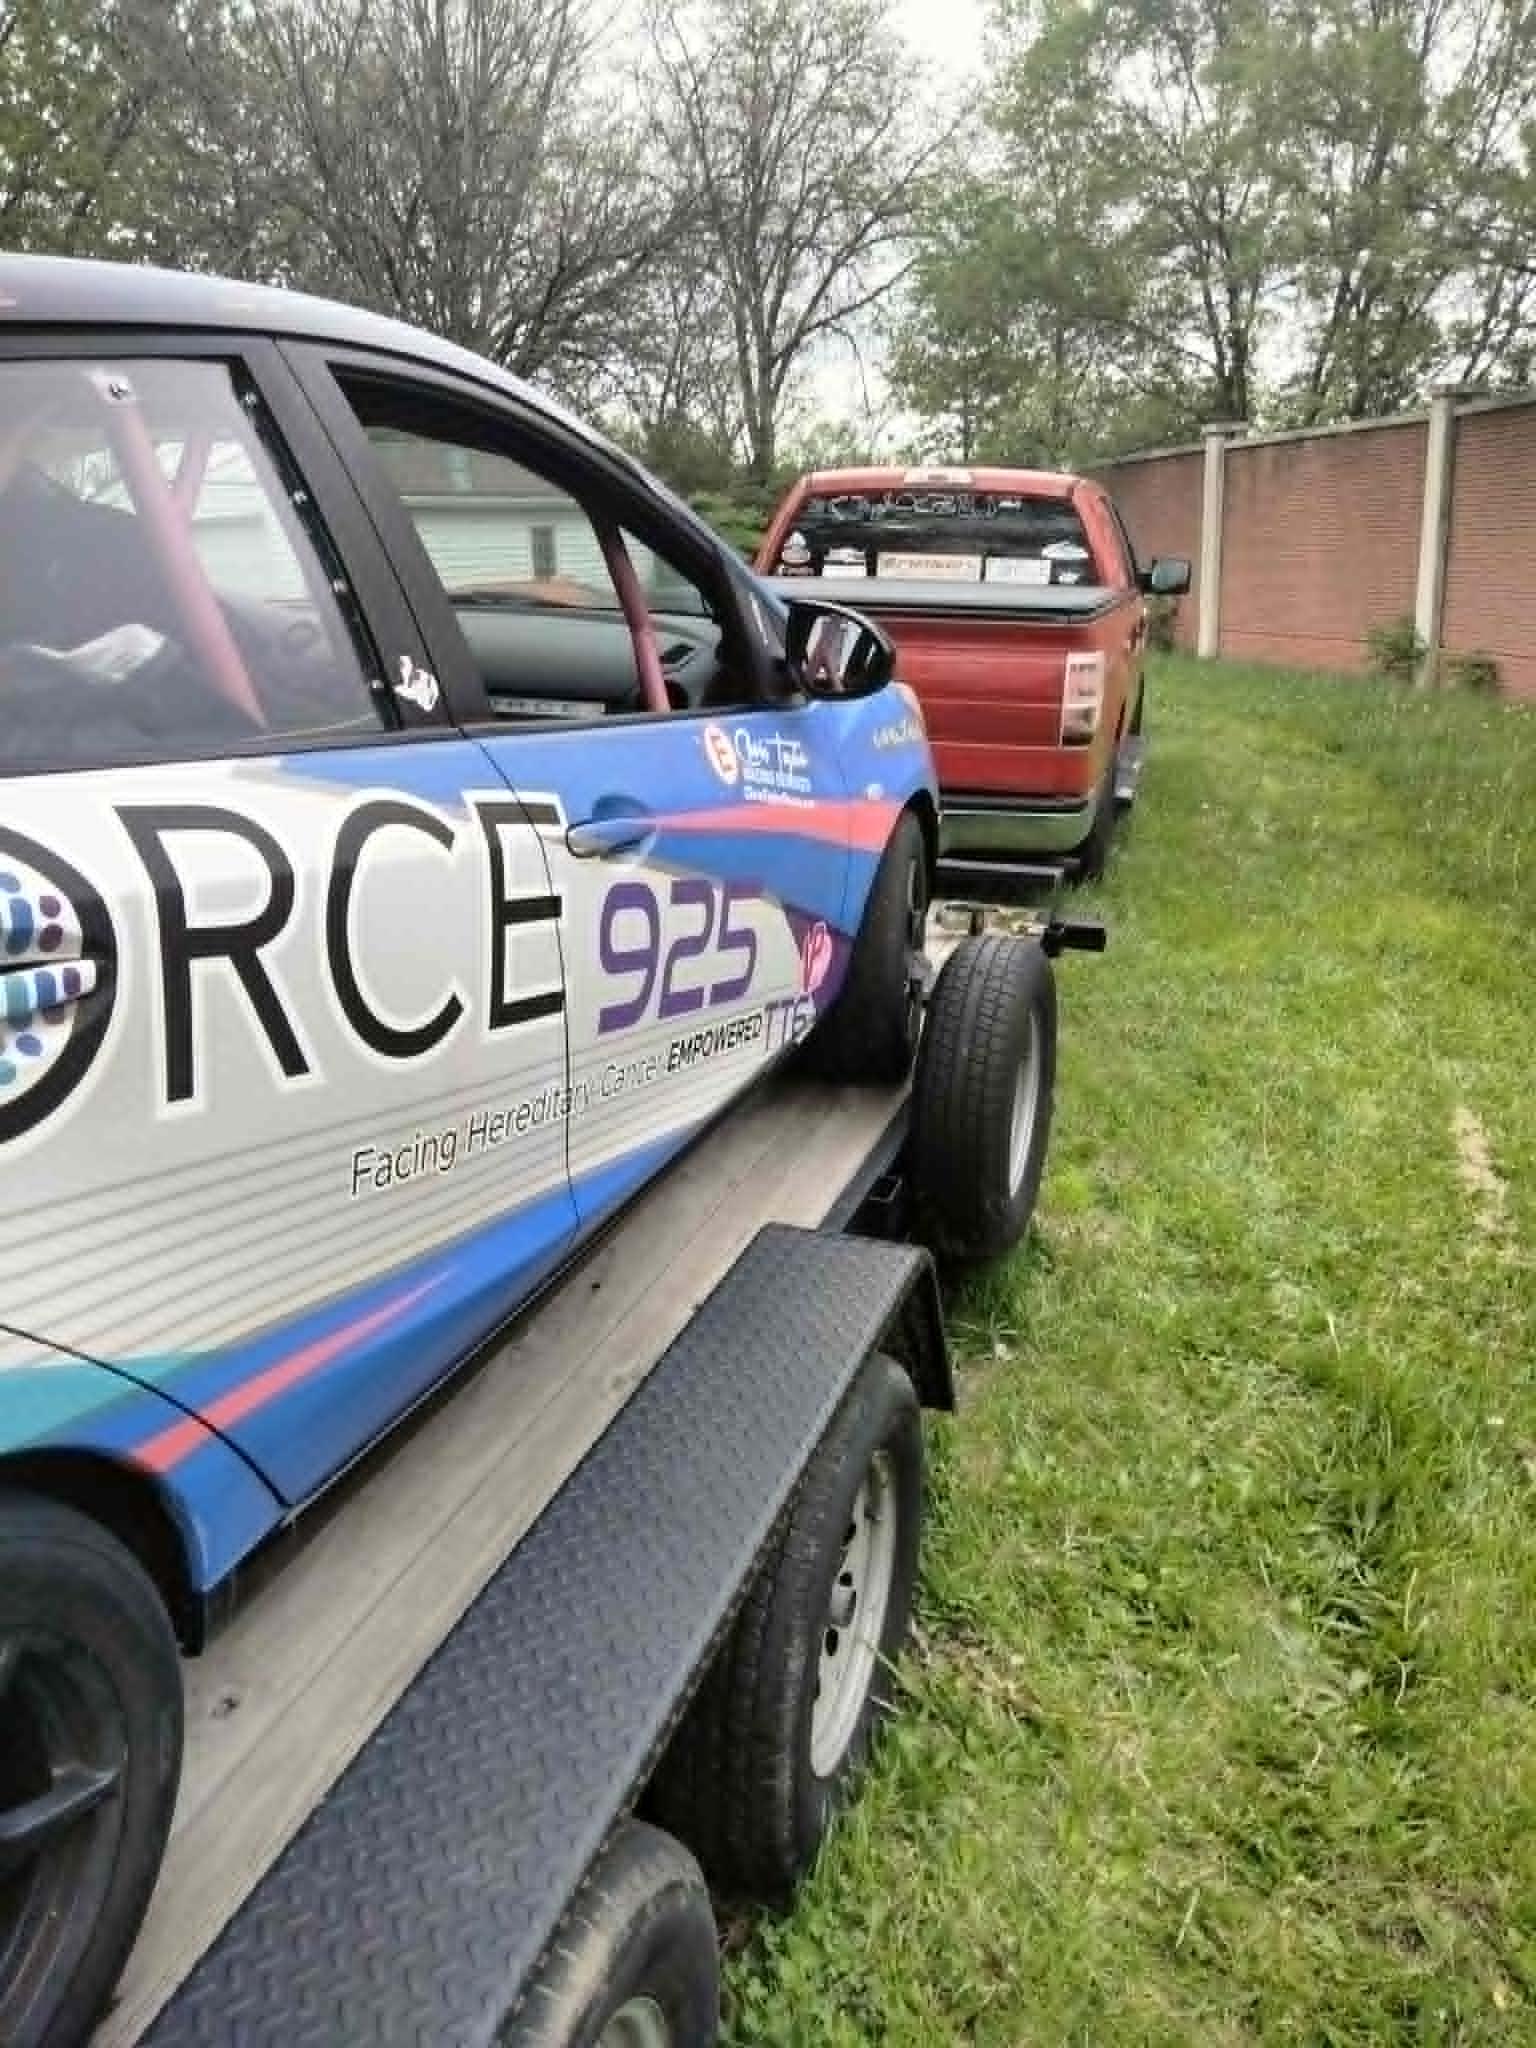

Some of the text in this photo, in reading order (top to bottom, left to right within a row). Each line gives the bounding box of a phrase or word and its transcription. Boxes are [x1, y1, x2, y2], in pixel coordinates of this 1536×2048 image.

[597, 879, 763, 1035] 925
[351, 1012, 762, 1196] Facing Hereditary Cancer EMPOWERED
